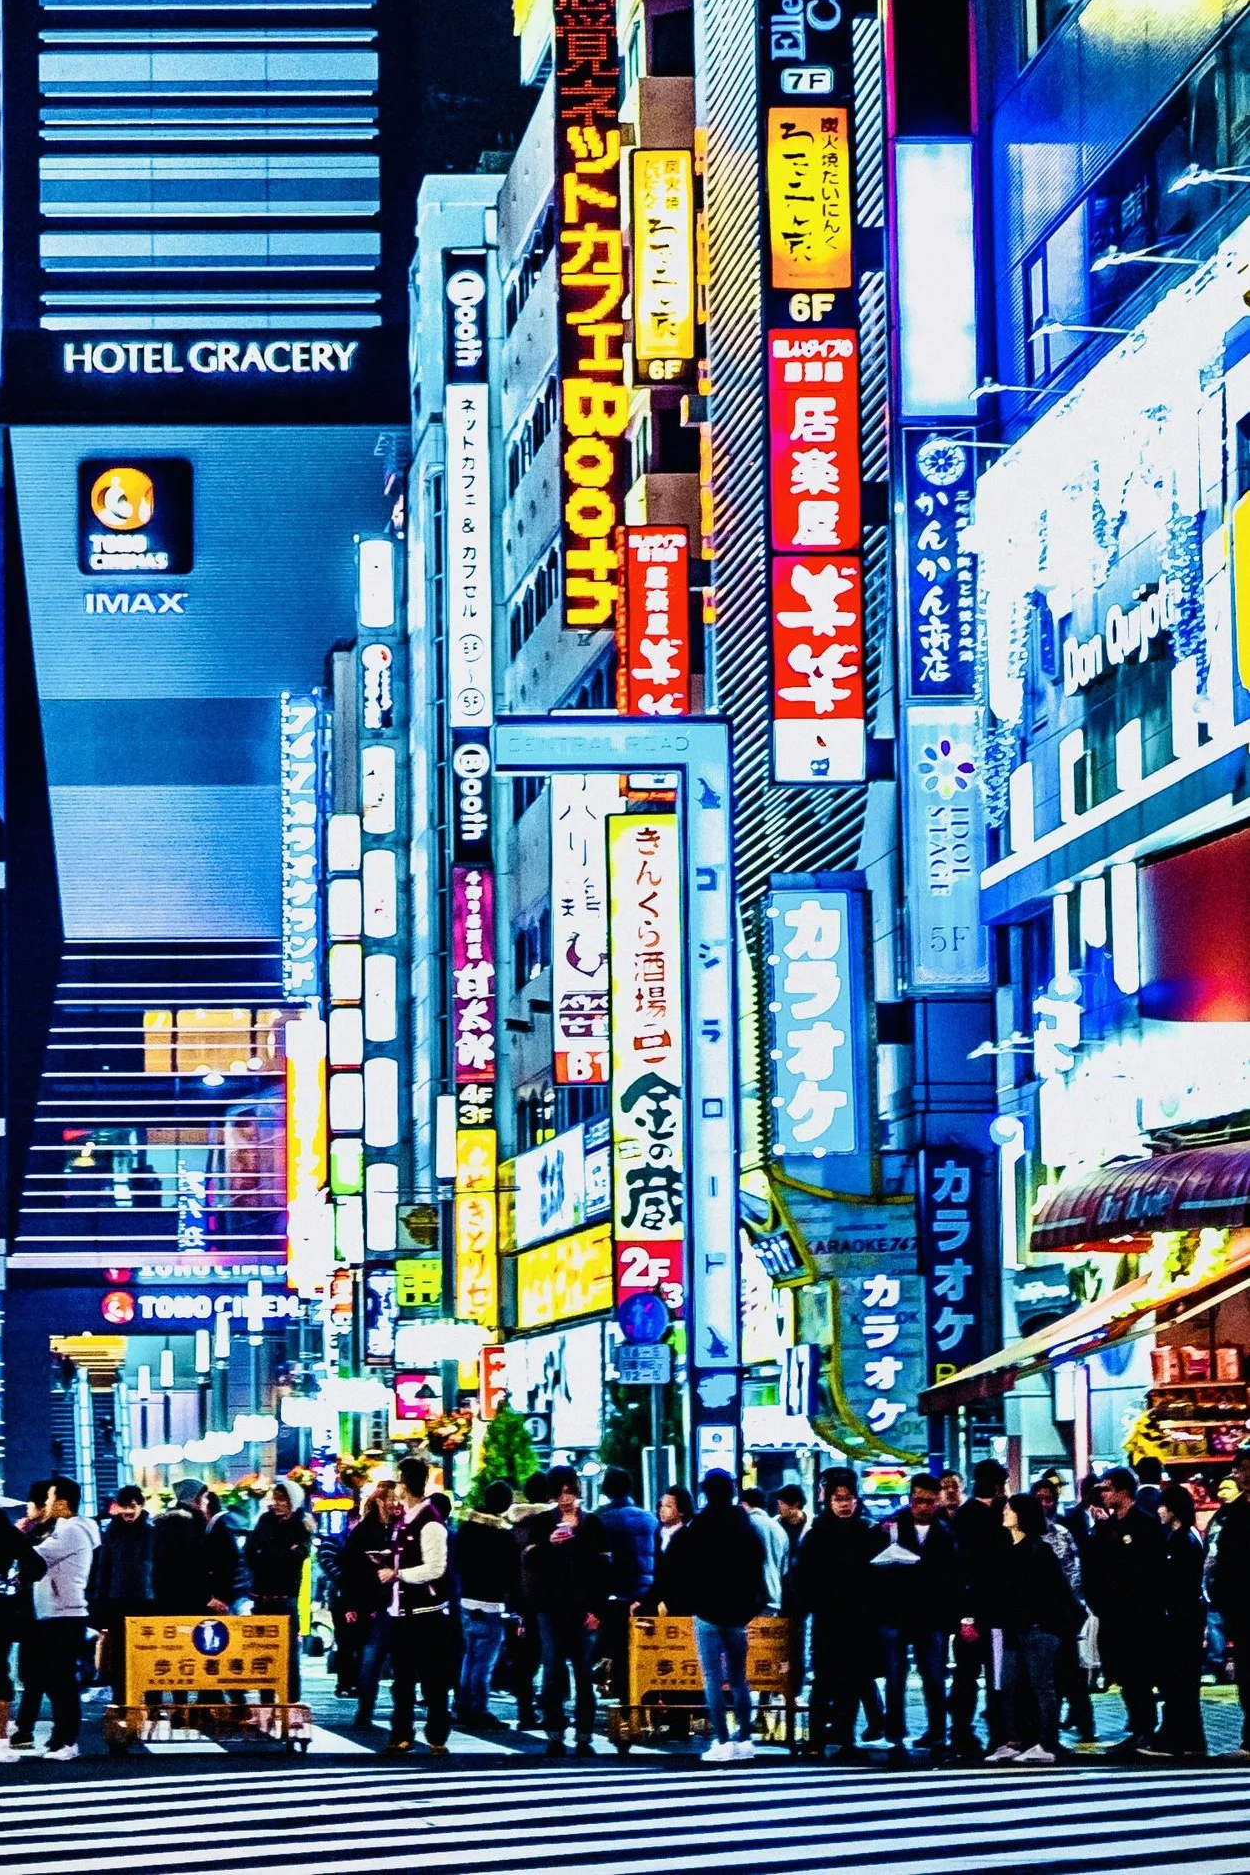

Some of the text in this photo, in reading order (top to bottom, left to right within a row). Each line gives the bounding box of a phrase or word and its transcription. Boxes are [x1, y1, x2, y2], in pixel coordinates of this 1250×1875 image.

[788, 72, 827, 90] 7F
[788, 293, 836, 322] 6F
[63, 341, 358, 374] HOTEL GRACERY
[648, 360, 682, 381] 6F
[85, 592, 186, 615] IMAX
[1063, 634, 1103, 697] Don
[635, 827, 666, 1018] きんくら酒場
[930, 926, 971, 953] 5F
[783, 900, 848, 1143] カラオケ
[567, 1052, 610, 1083] B1
[458, 1084, 493, 1105] 4F
[458, 1105, 493, 1125] 3F
[620, 1071, 685, 1232] 金の蔵
[619, 1246, 670, 1288] 2F
[931, 1161, 975, 1352] カラオケ
[862, 1274, 907, 1433] カラオケ
